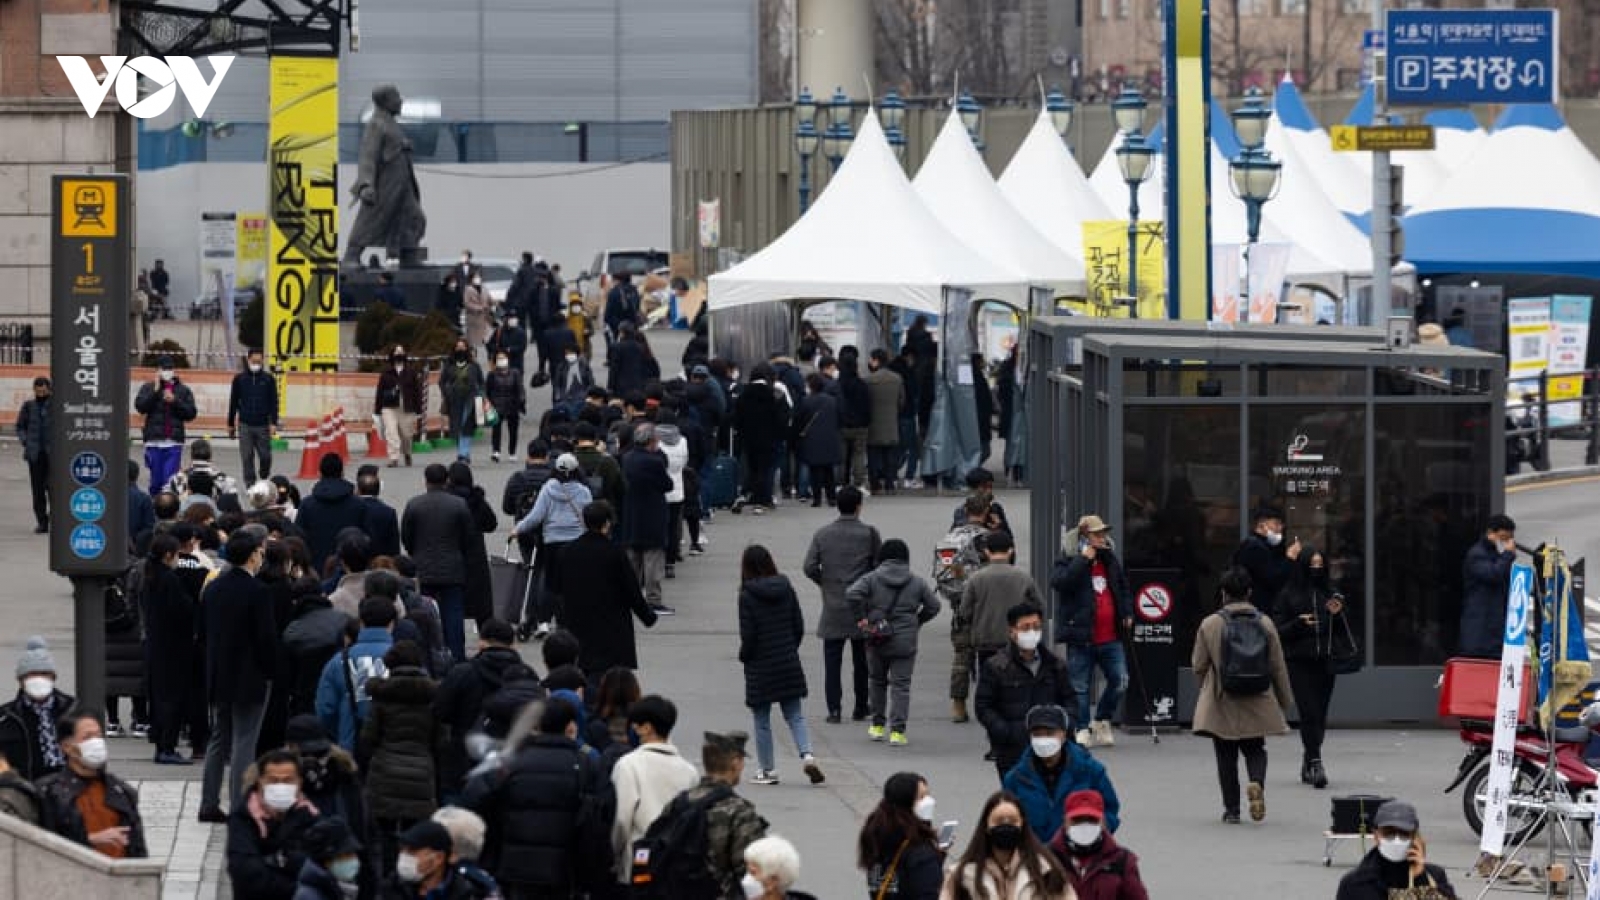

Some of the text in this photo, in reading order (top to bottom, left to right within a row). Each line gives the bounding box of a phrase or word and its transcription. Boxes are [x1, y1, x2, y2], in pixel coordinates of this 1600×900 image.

[1394, 24, 1432, 38] 서울역
[1432, 55, 1516, 91] 주차장
[82, 242, 94, 273] 1
[309, 163, 338, 371] TRIPL
[74, 303, 103, 398] 서울역
[64, 402, 113, 413] Seoul Station
[75, 467, 101, 477] 1호선
[1272, 466, 1342, 475] SMOKING AREA
[1286, 480, 1329, 494] 흡연구역
[75, 503, 101, 513] 4호선
[1135, 624, 1172, 636] 금연구역
